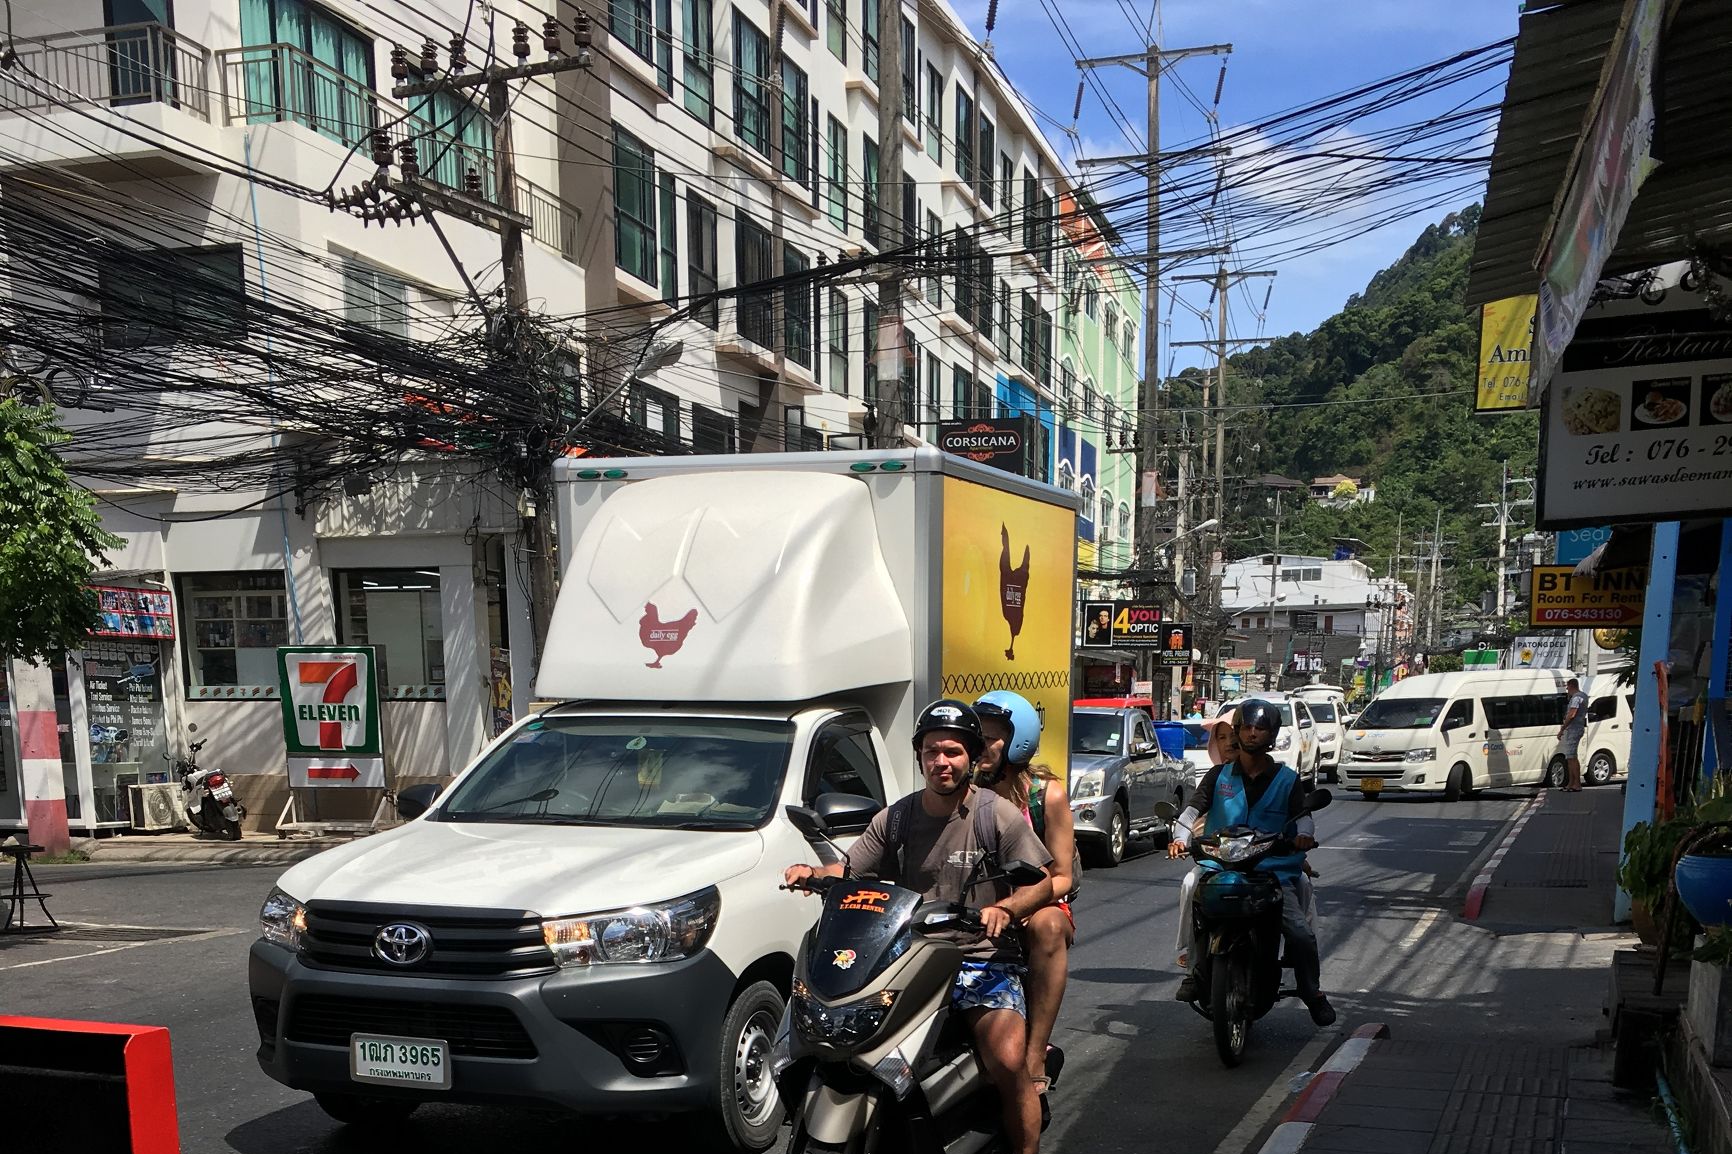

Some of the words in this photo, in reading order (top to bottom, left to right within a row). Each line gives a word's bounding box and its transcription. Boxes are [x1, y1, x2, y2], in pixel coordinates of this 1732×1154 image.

[1488, 344, 1532, 362] Am
[946, 436, 1017, 447] CORSICANA
[1647, 438, 1690, 460] 076
[1538, 572, 1576, 591] BT
[1537, 593, 1575, 604] Room
[1582, 593, 1604, 603] For
[1611, 592, 1643, 603] Rent
[1545, 609, 1622, 619] 076-343130
[1113, 607, 1130, 633] 4
[1130, 610, 1160, 624] you
[1130, 623, 1159, 633] OPTIC
[650, 630, 665, 640] daily
[666, 632, 678, 641] egg
[1536, 650, 1564, 658] HOTEL
[99, 692, 112, 701] Service
[106, 704, 120, 713] Service
[298, 662, 357, 750] 7
[398, 1044, 441, 1067] 3965
